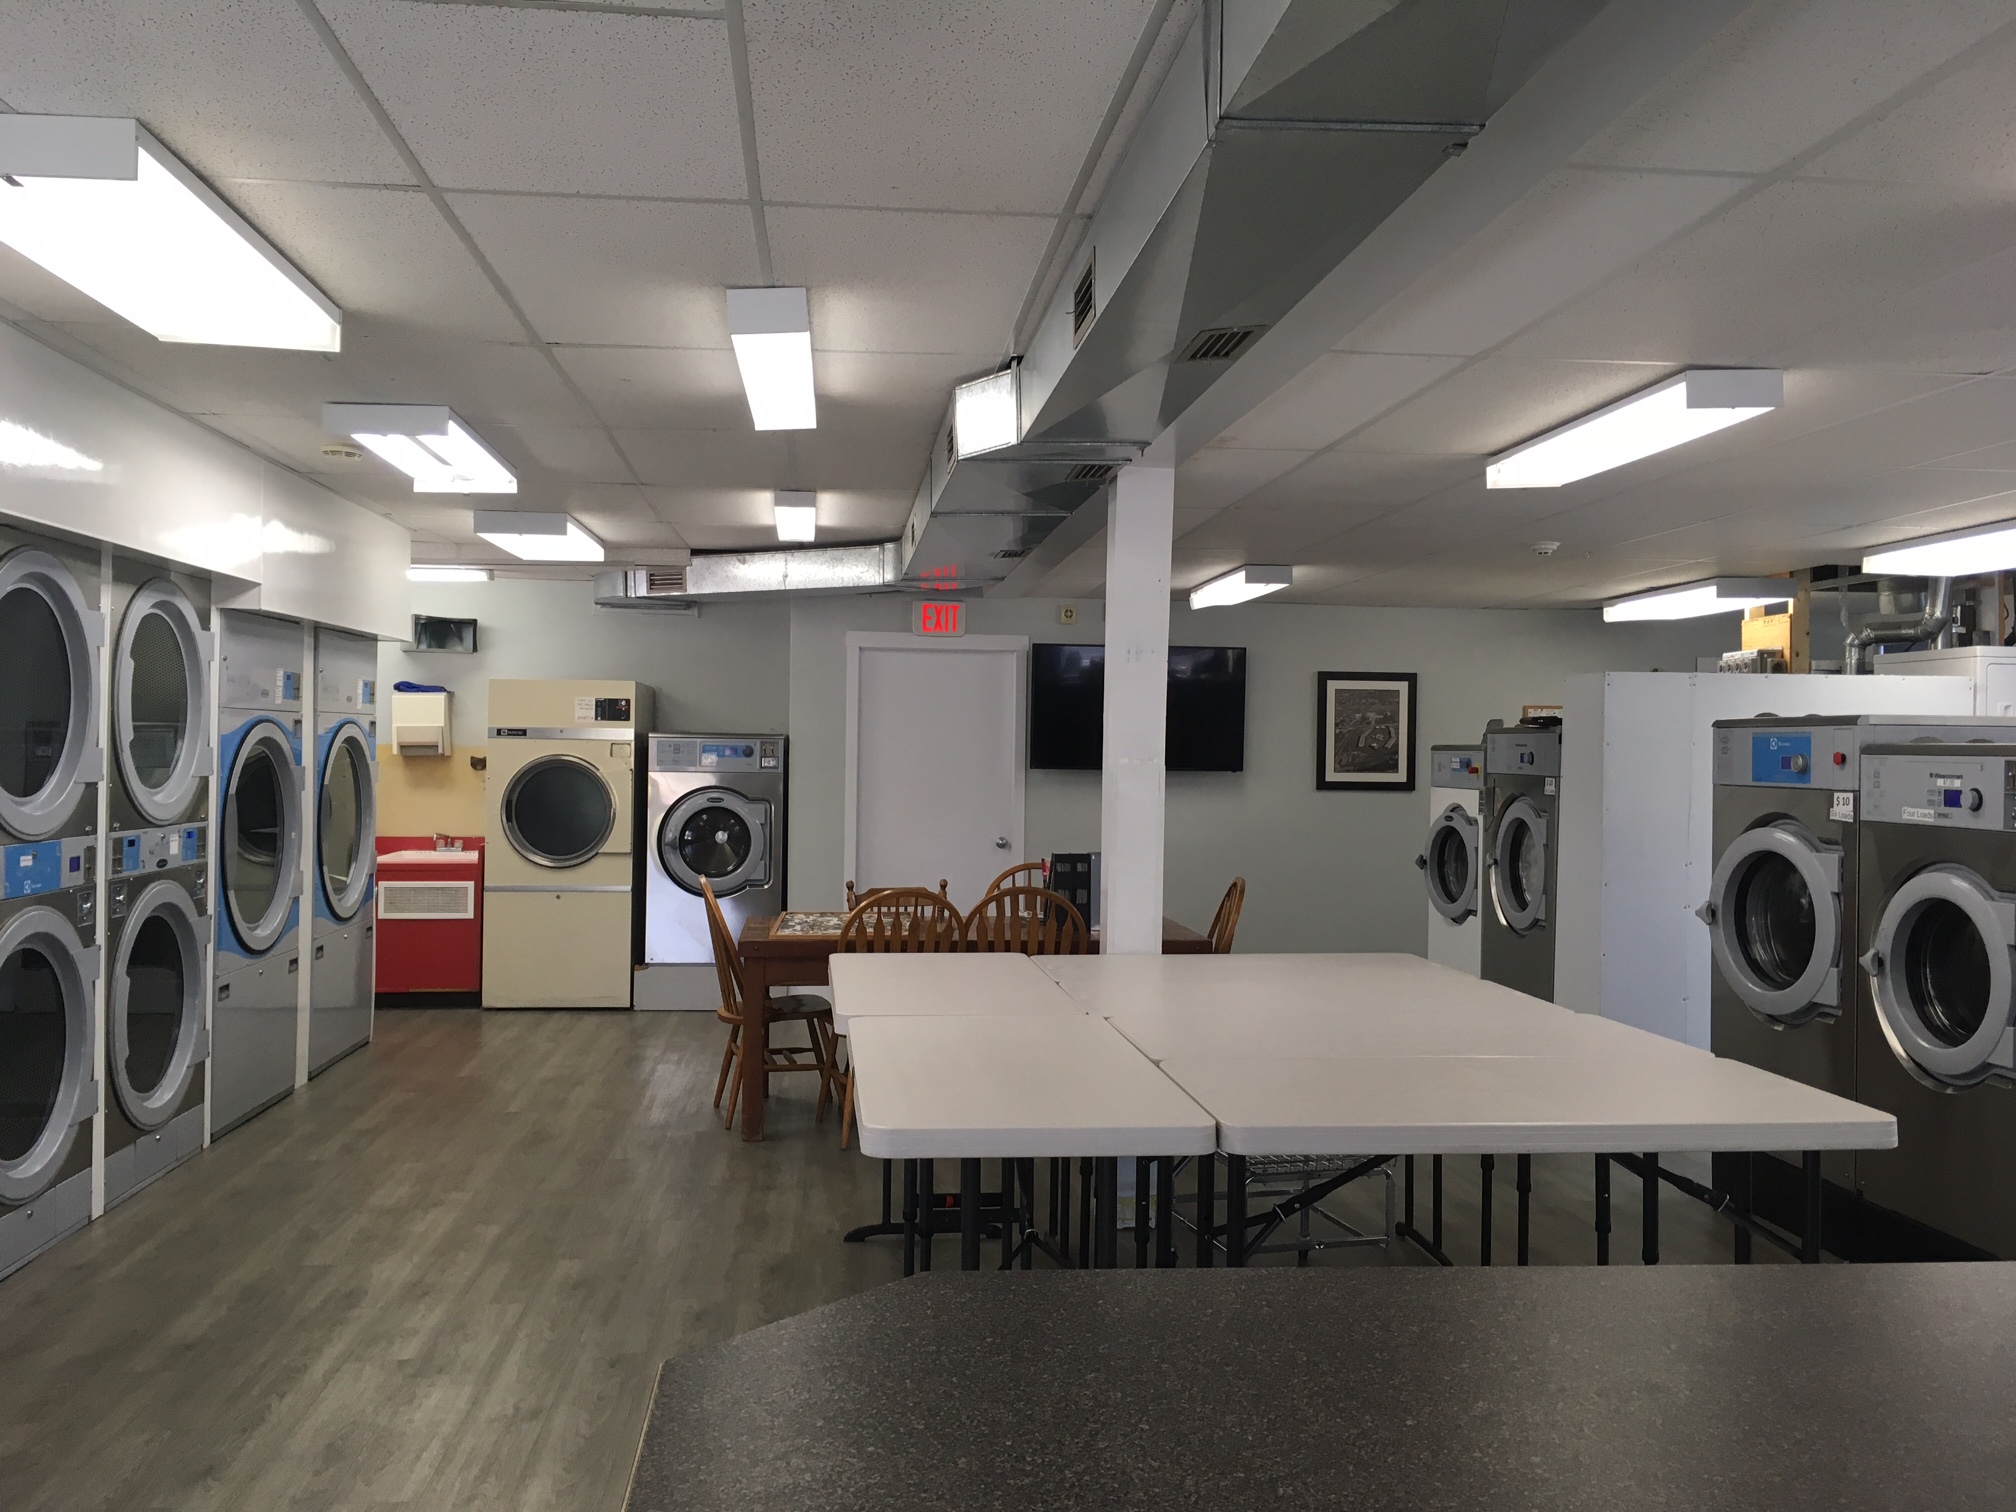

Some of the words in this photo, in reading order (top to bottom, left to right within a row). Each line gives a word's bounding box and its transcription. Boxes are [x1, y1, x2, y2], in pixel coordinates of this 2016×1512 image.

[922, 603, 960, 632] EXIT
[1842, 796, 1851, 807] 10
[1903, 808, 1916, 817] Four
[1917, 809, 1934, 820] Loads
